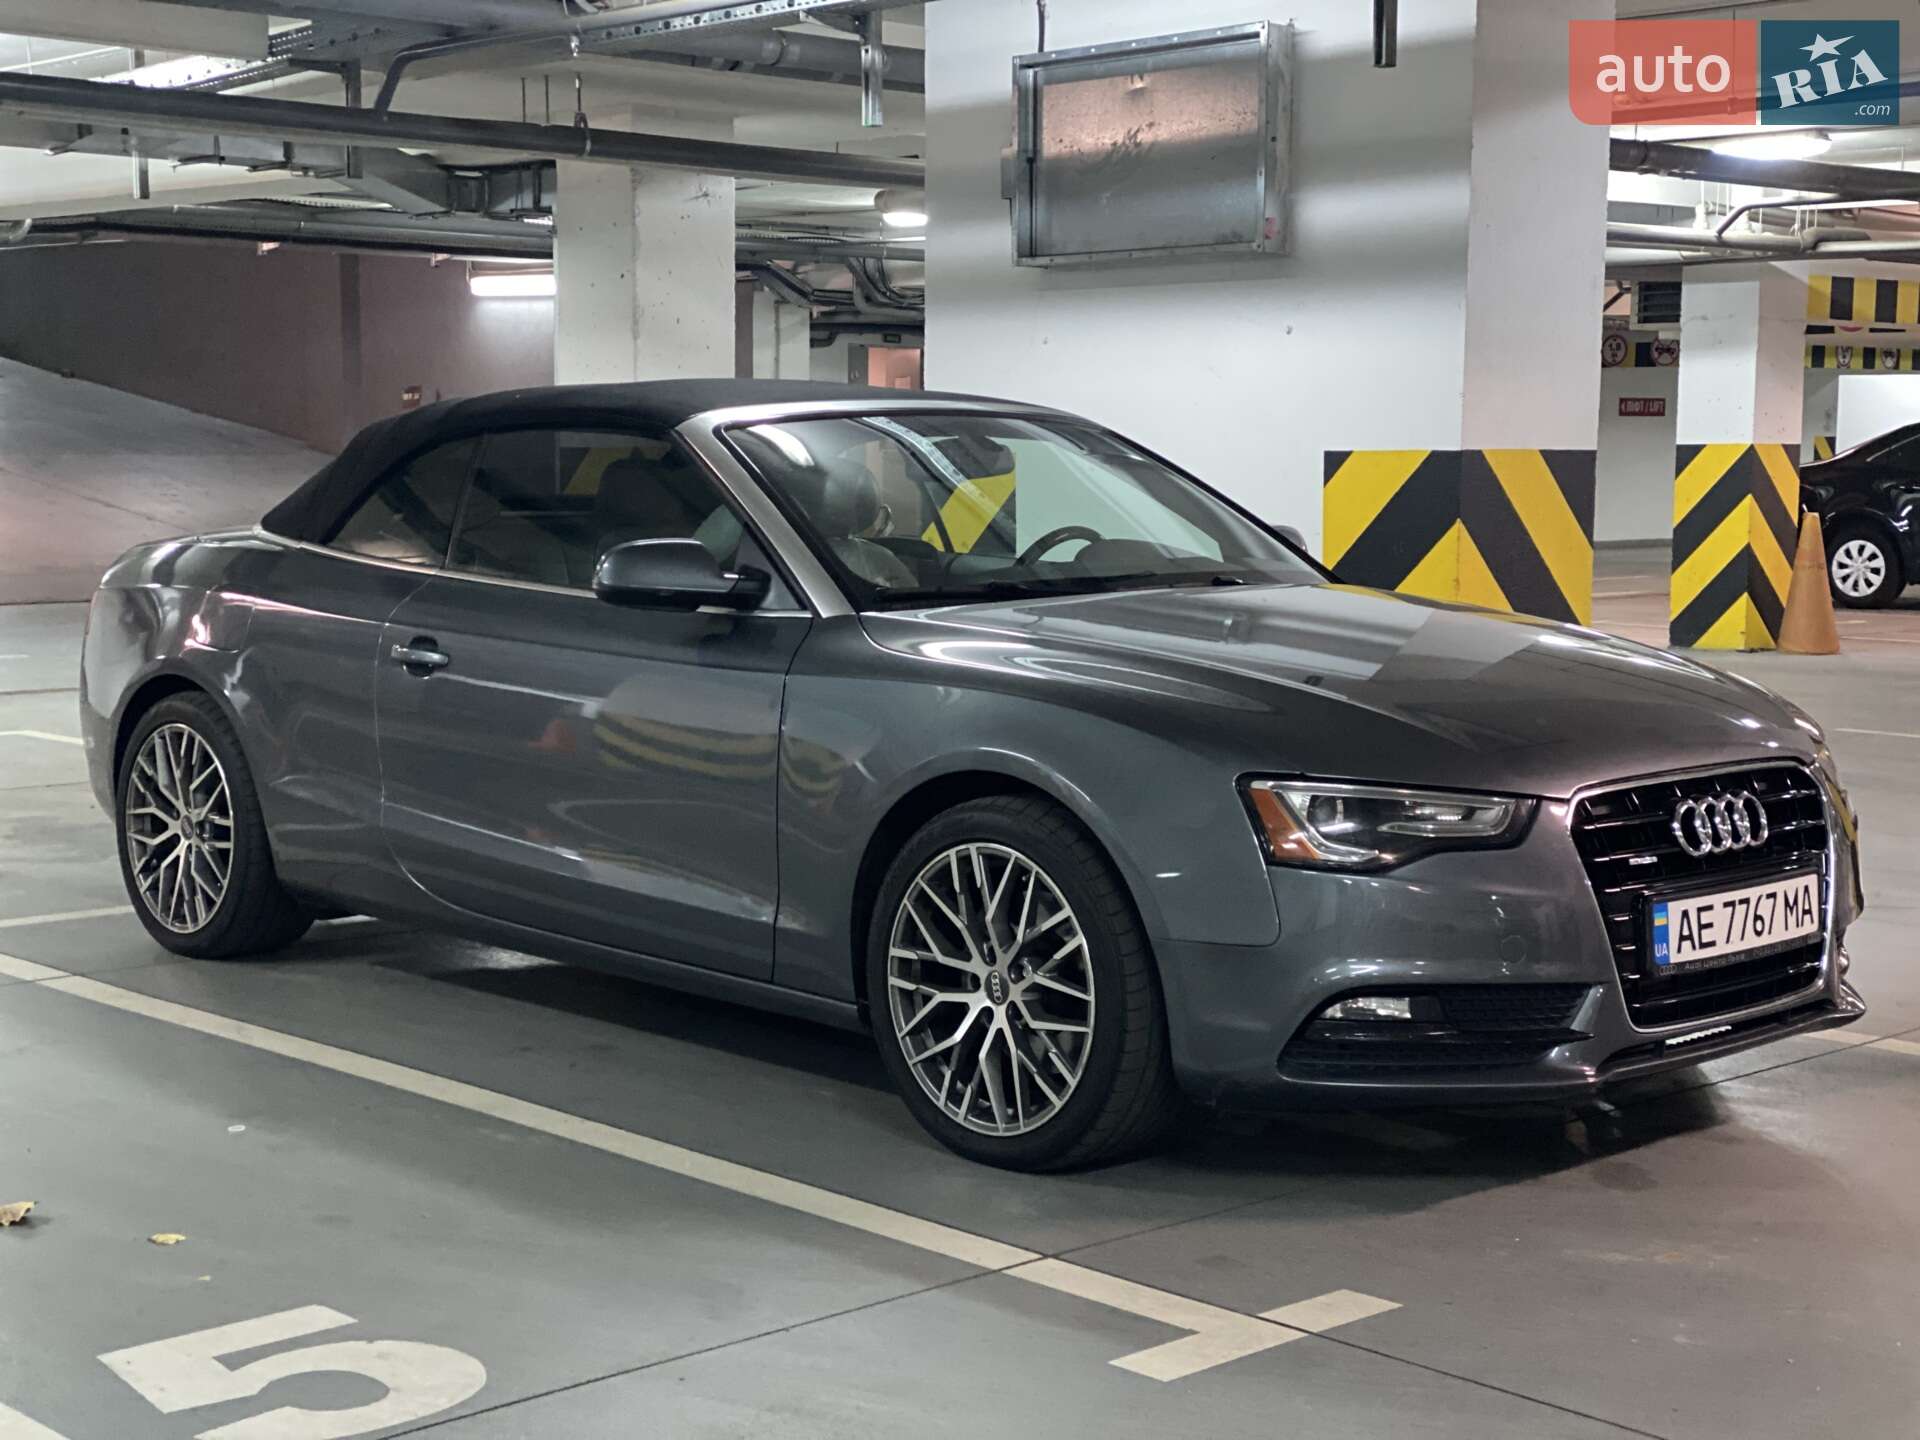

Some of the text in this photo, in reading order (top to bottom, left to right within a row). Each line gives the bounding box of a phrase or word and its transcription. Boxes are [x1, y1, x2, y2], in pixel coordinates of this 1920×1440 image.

[1654, 943, 1669, 957] UA
[1677, 884, 1814, 955] AE 7767 MA
[97, 1304, 487, 1440] 5
